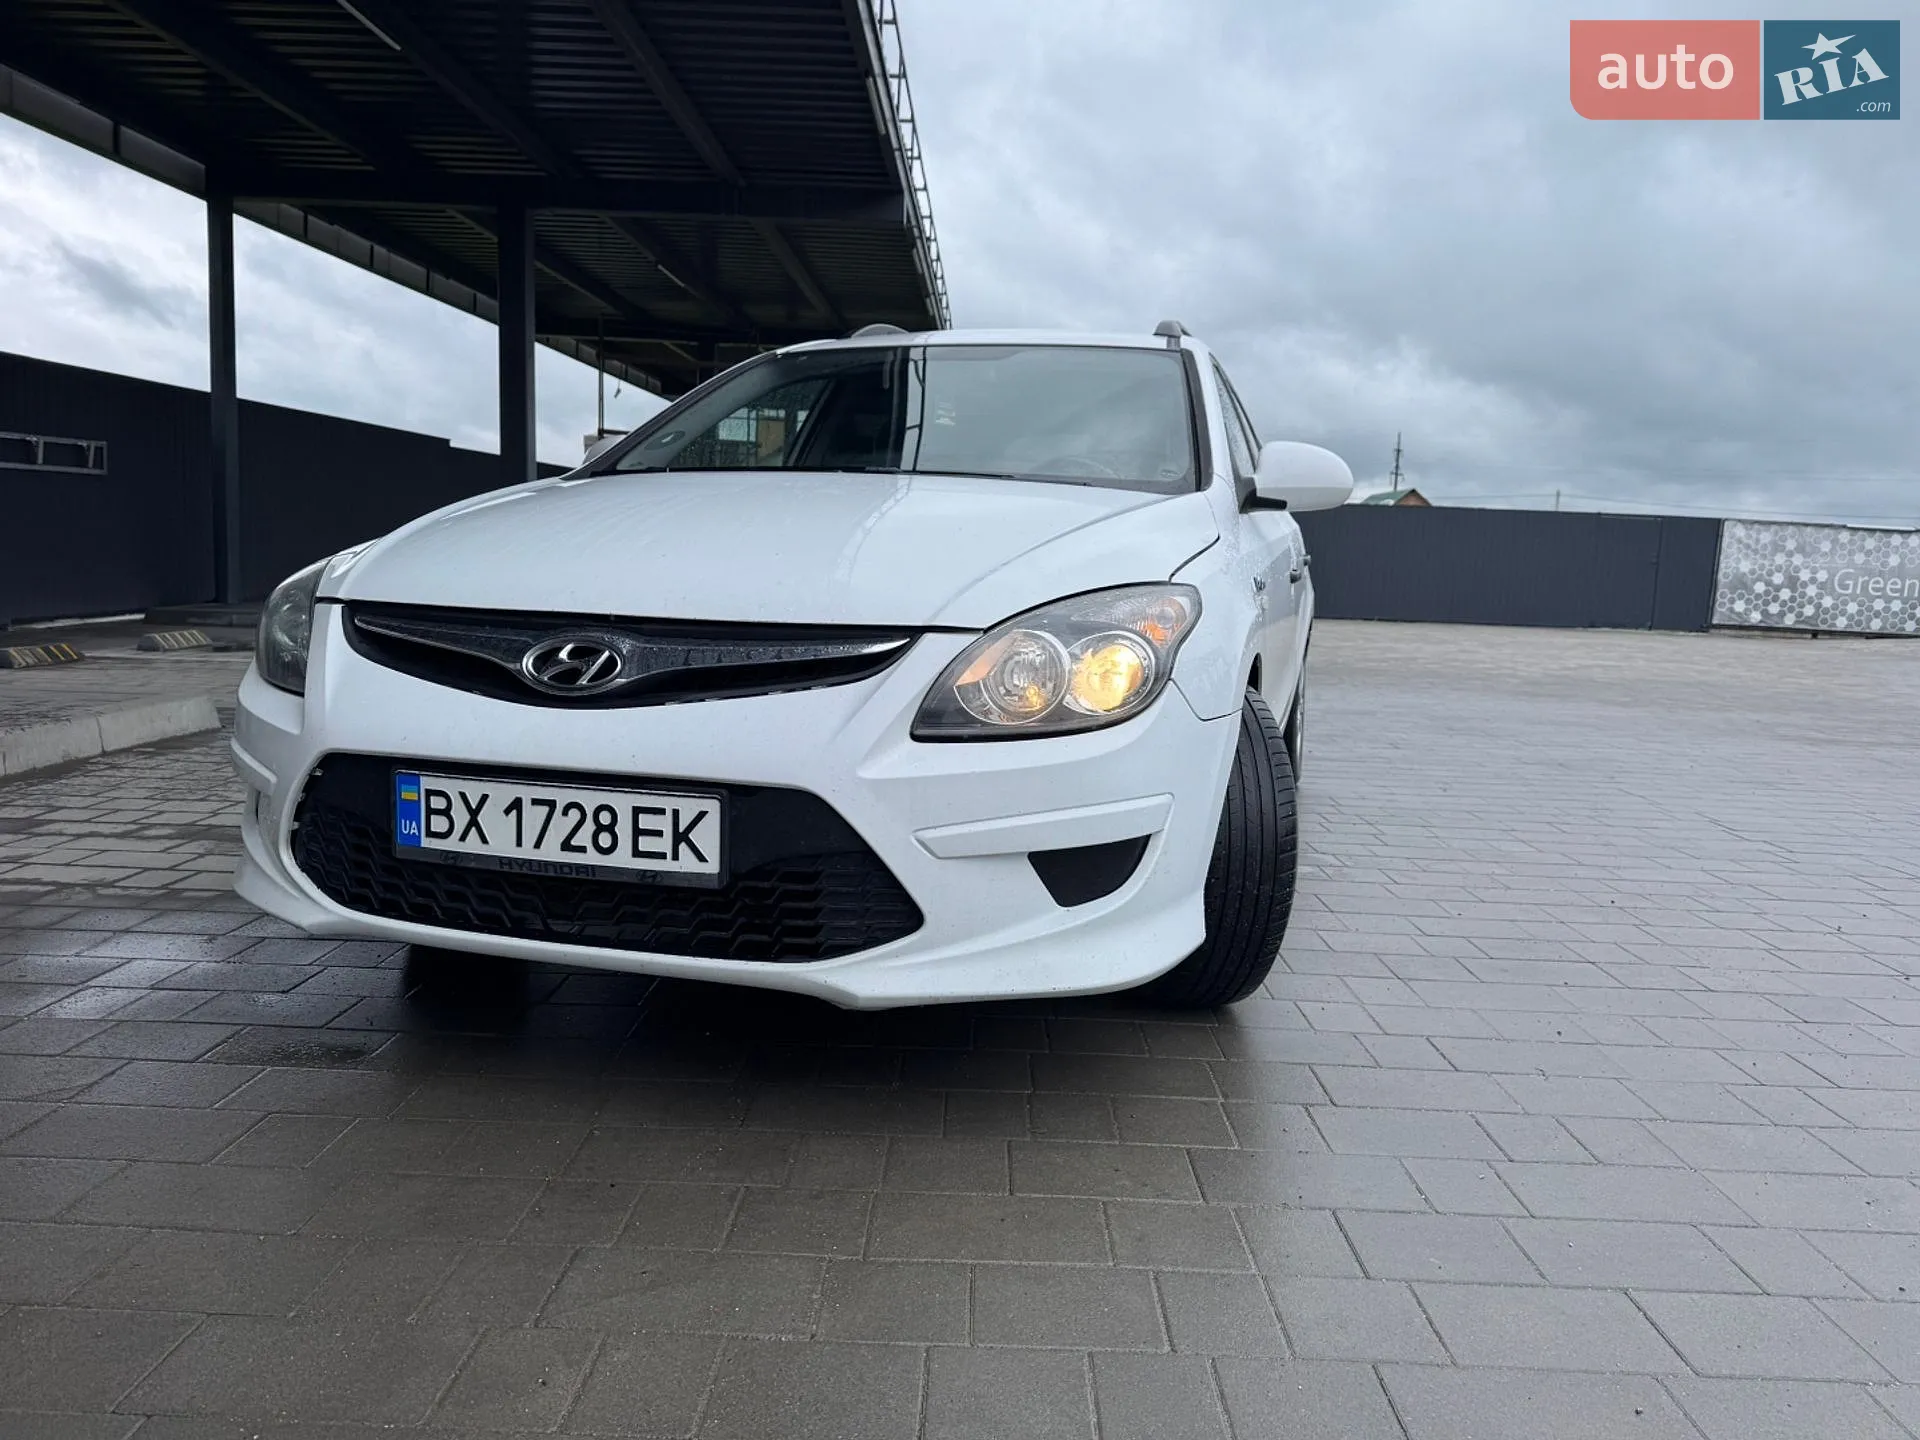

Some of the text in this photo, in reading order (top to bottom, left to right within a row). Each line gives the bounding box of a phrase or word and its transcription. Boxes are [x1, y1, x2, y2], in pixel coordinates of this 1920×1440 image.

[1834, 568, 1920, 598] Green
[401, 818, 419, 837] UA
[424, 788, 709, 863] BX 1728 EK
[498, 857, 597, 878] HYUNDAI
